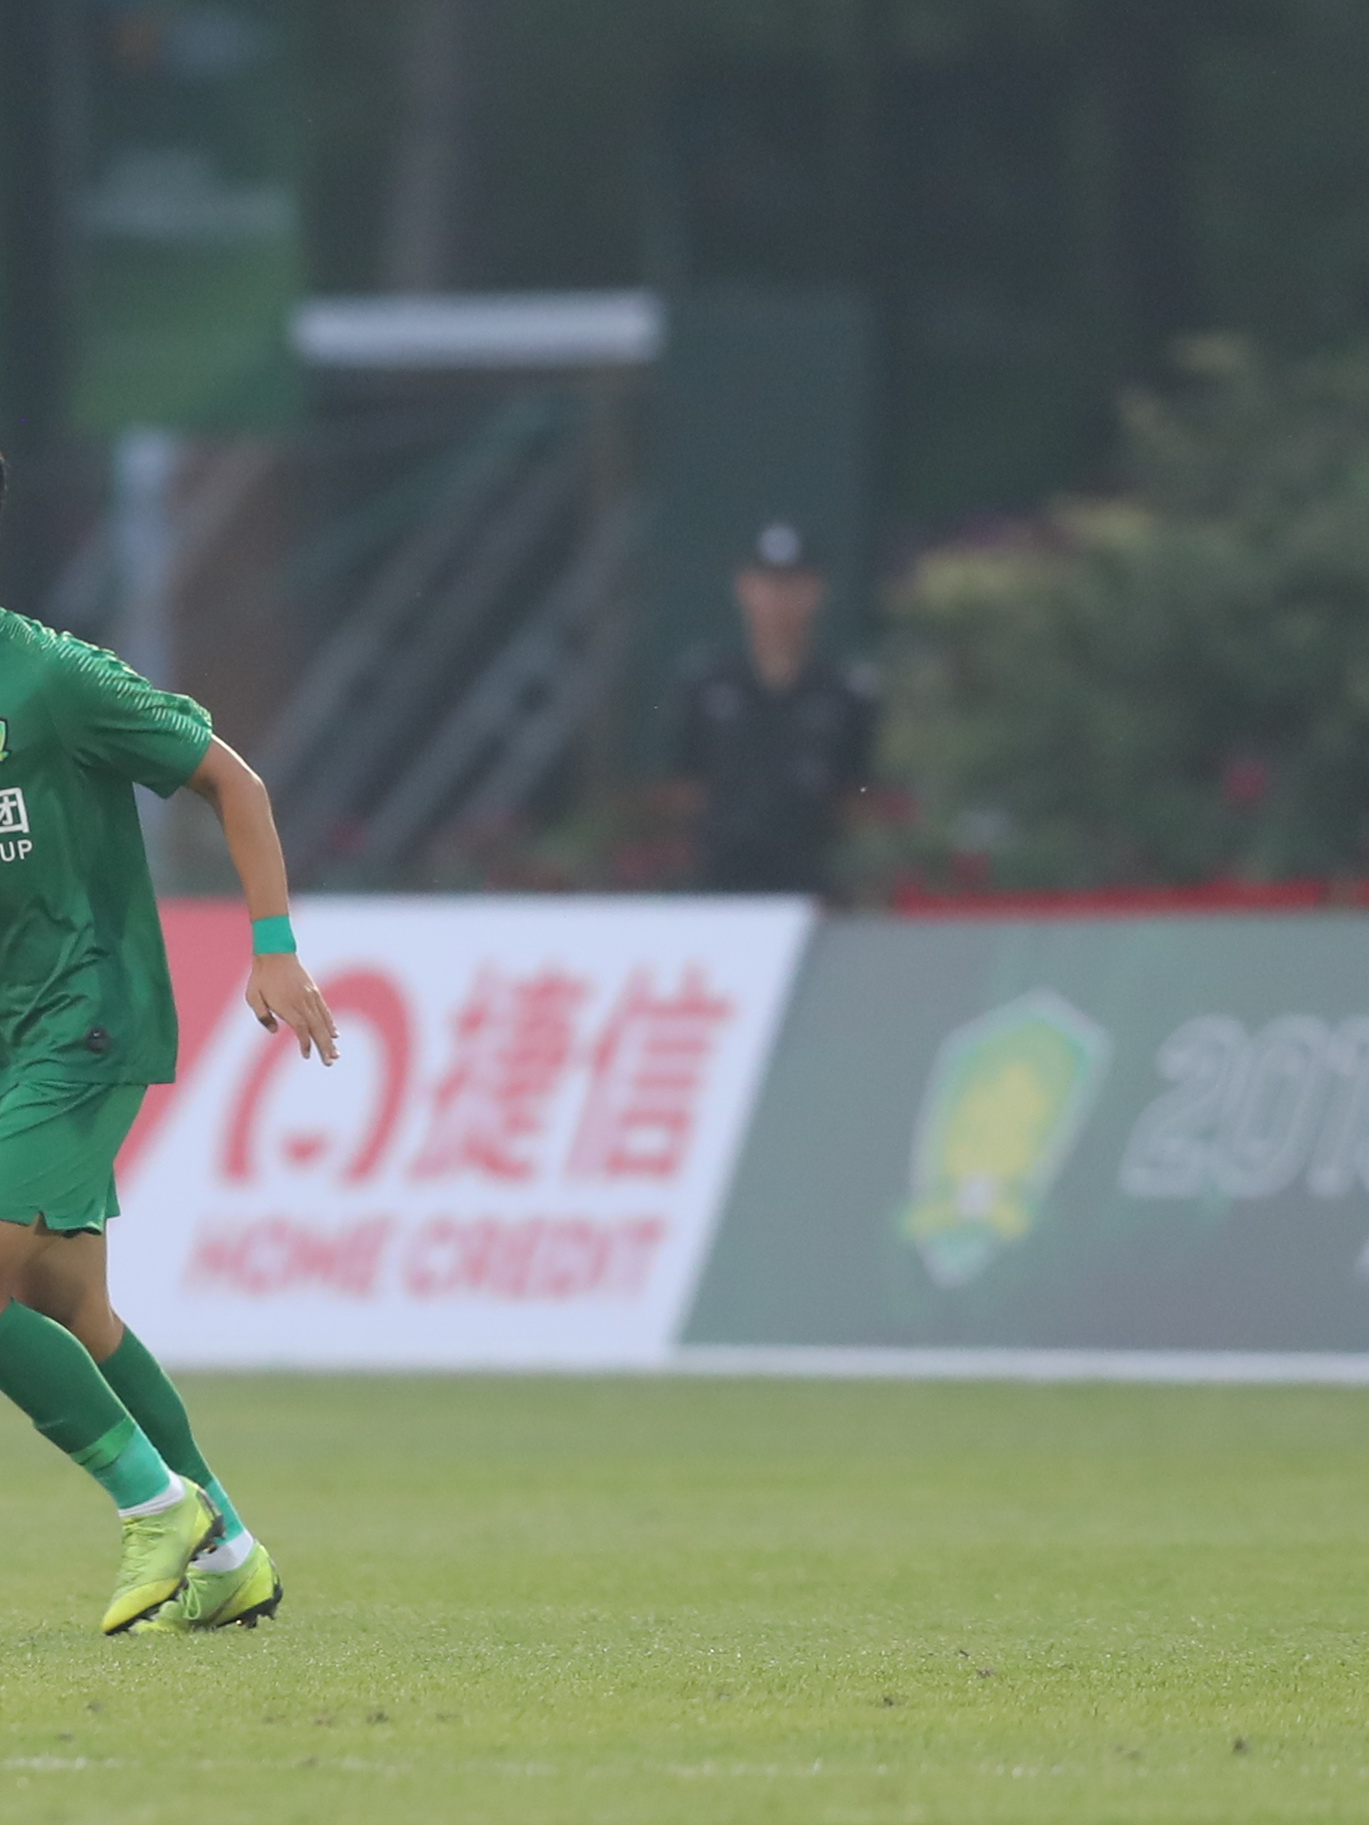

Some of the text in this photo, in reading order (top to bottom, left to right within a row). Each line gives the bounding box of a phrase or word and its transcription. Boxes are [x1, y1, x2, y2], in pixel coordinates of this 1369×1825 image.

[405, 958, 736, 1186] 捷信
[1118, 1013, 1369, 1199] 201
[182, 1214, 669, 1301] HOME CREDIT
